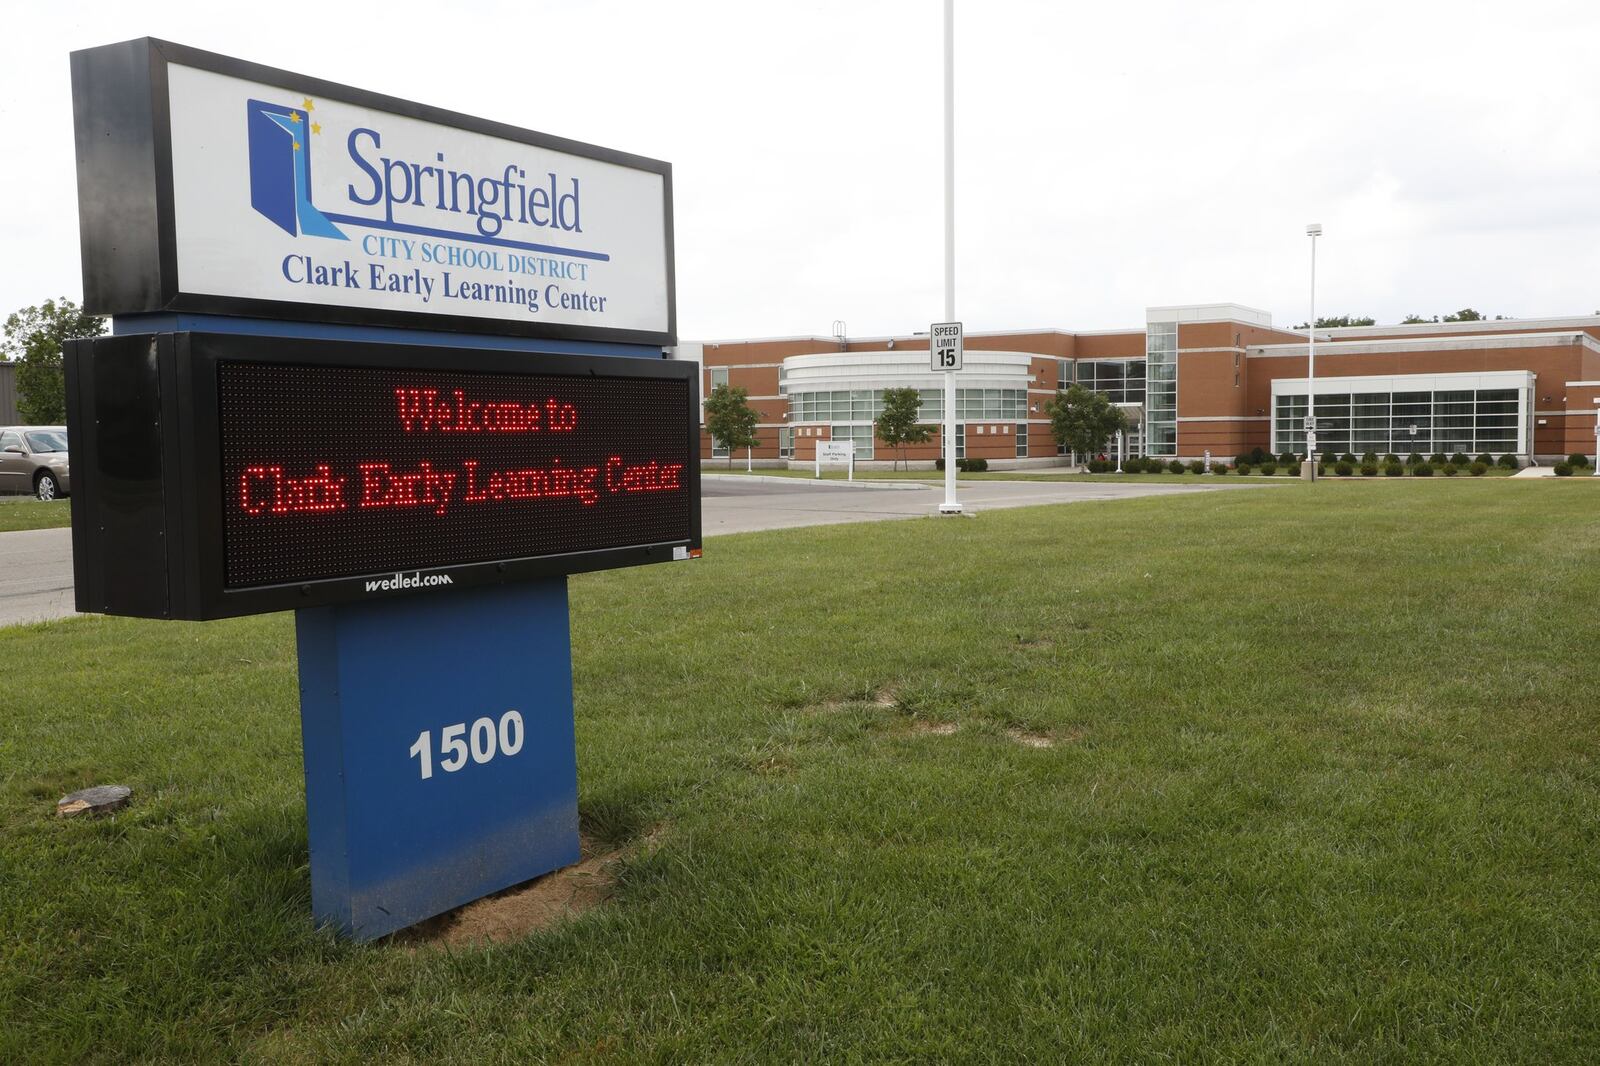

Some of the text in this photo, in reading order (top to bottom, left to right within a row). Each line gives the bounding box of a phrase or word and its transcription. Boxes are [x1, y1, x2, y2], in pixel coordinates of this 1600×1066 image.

[347, 128, 582, 236] Springfield
[362, 234, 588, 281] CITY SCHOOL DISTRICT
[282, 254, 607, 313] Clark Early Learning Center
[934, 326, 959, 337] SPEED
[936, 338, 957, 348] LIMIT
[937, 349, 956, 367] 15
[395, 389, 577, 431] Welcome to
[241, 456, 683, 514] Clark Early Learning Center
[365, 572, 453, 592] wedled.com
[410, 710, 524, 780] 1500
